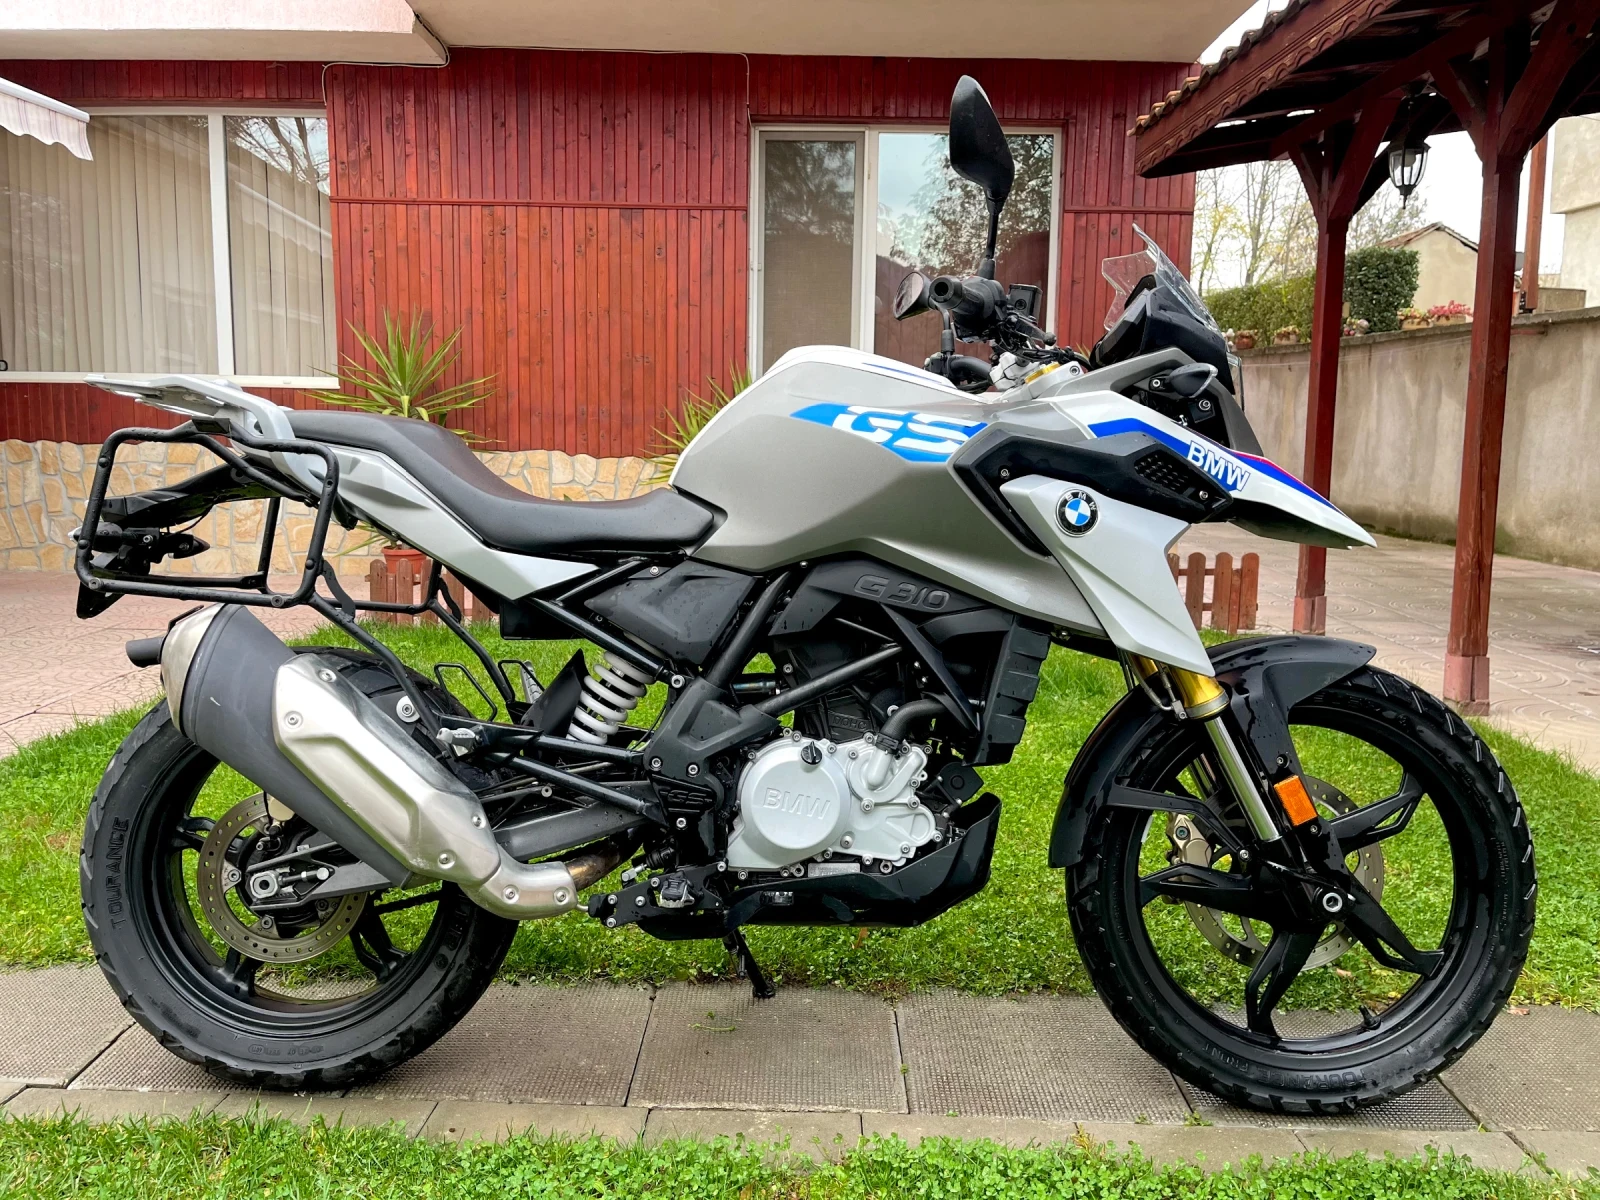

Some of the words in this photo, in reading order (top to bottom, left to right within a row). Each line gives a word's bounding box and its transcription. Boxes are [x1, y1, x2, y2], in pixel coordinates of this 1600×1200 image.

[831, 405, 983, 454] GS
[1186, 439, 1251, 492] BMW
[854, 574, 890, 598] G
[887, 581, 951, 610] 310
[762, 787, 831, 820] BMW
[105, 816, 130, 930] TOURANCE
